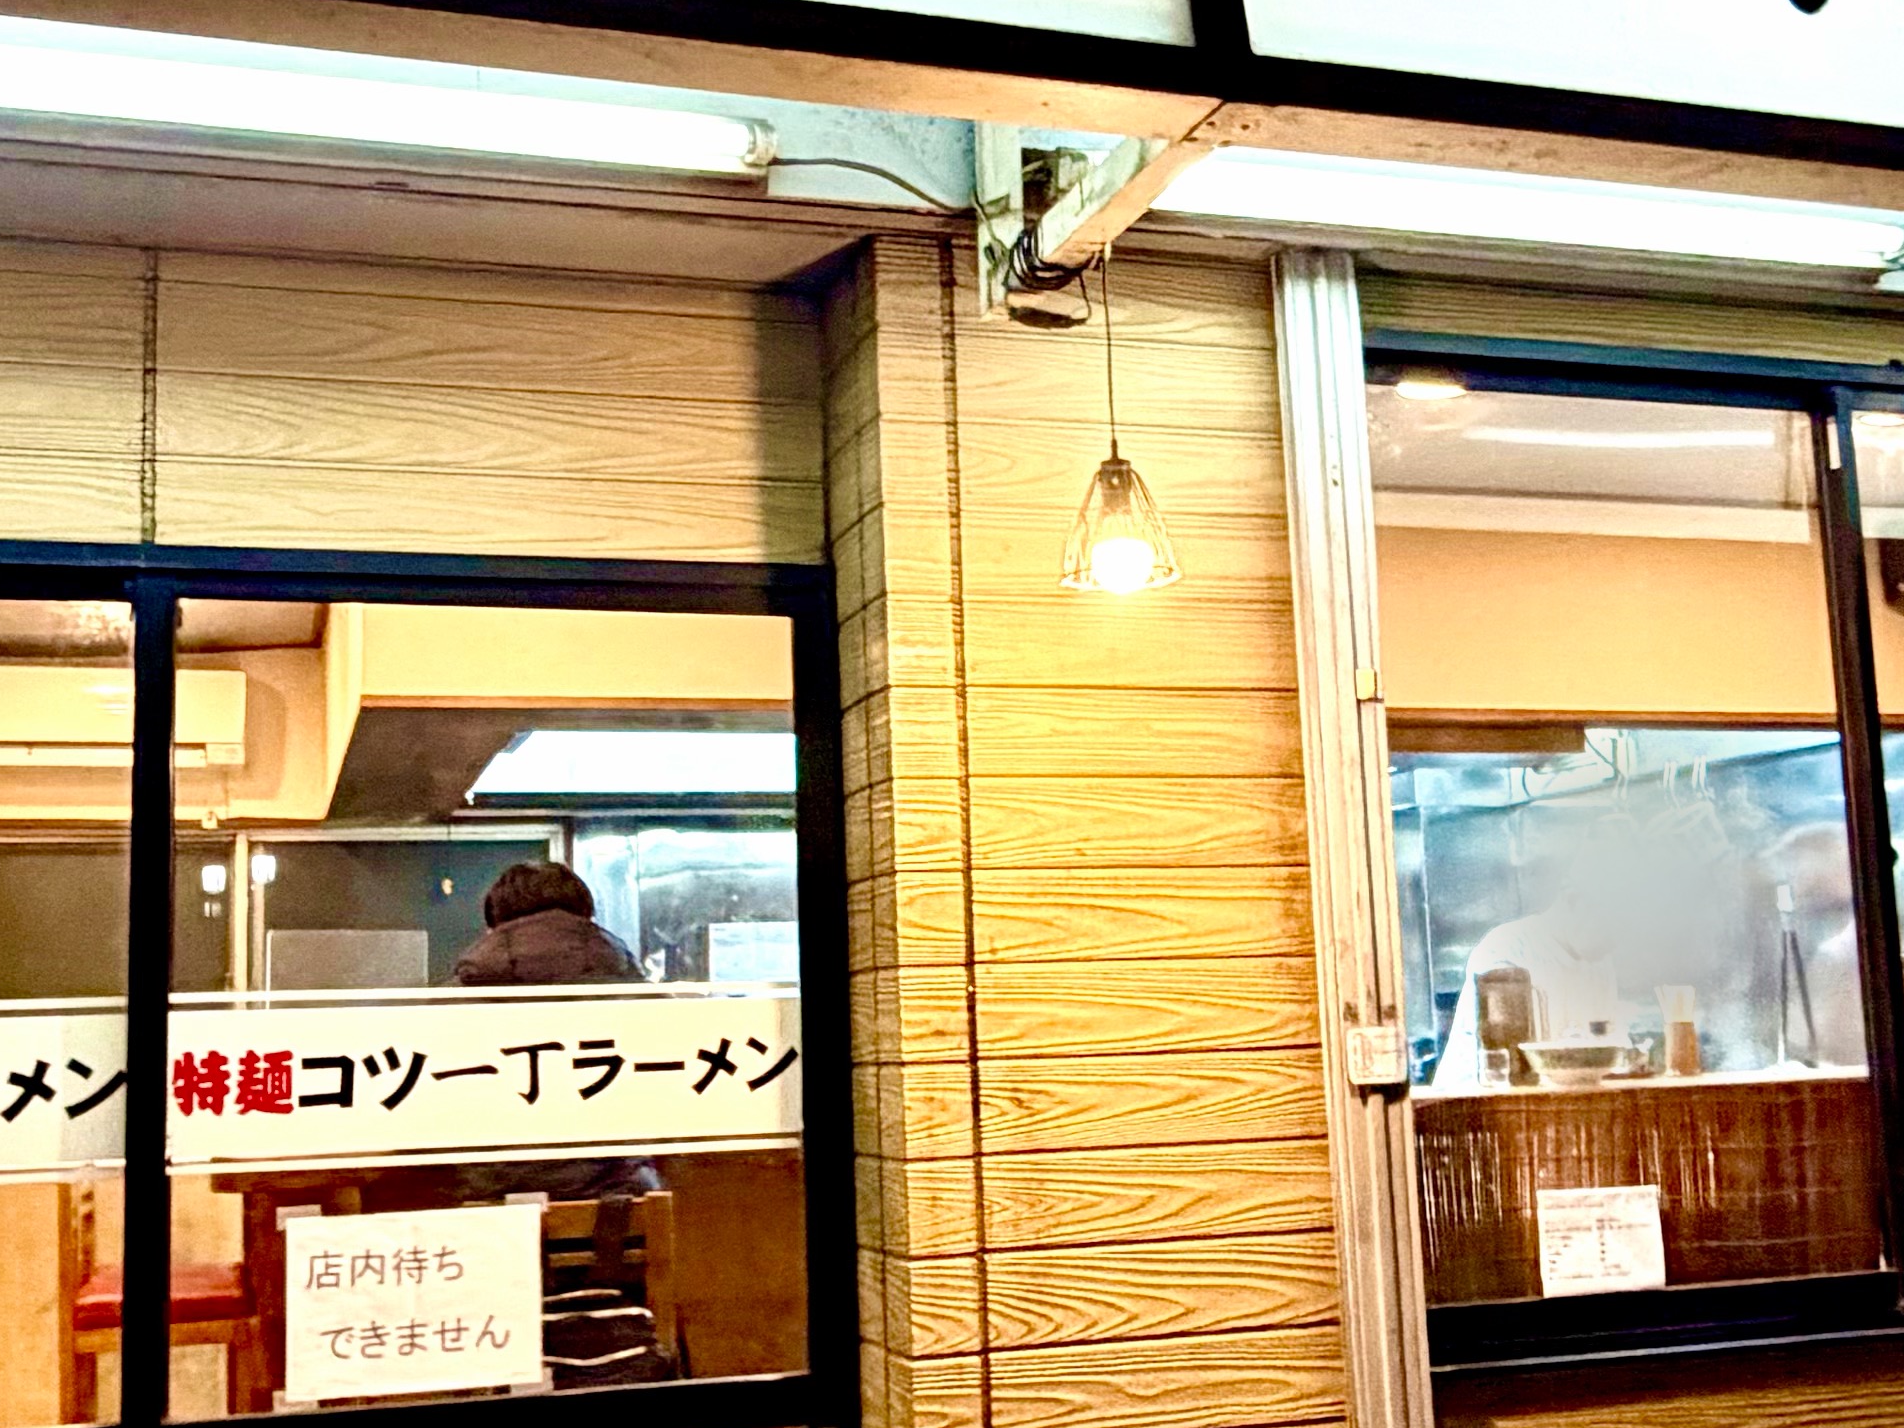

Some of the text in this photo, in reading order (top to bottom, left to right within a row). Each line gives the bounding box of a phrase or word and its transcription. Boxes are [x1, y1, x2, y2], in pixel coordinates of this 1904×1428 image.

[306, 1247, 464, 1290] 店内待ち
[321, 1314, 510, 1360] できません
